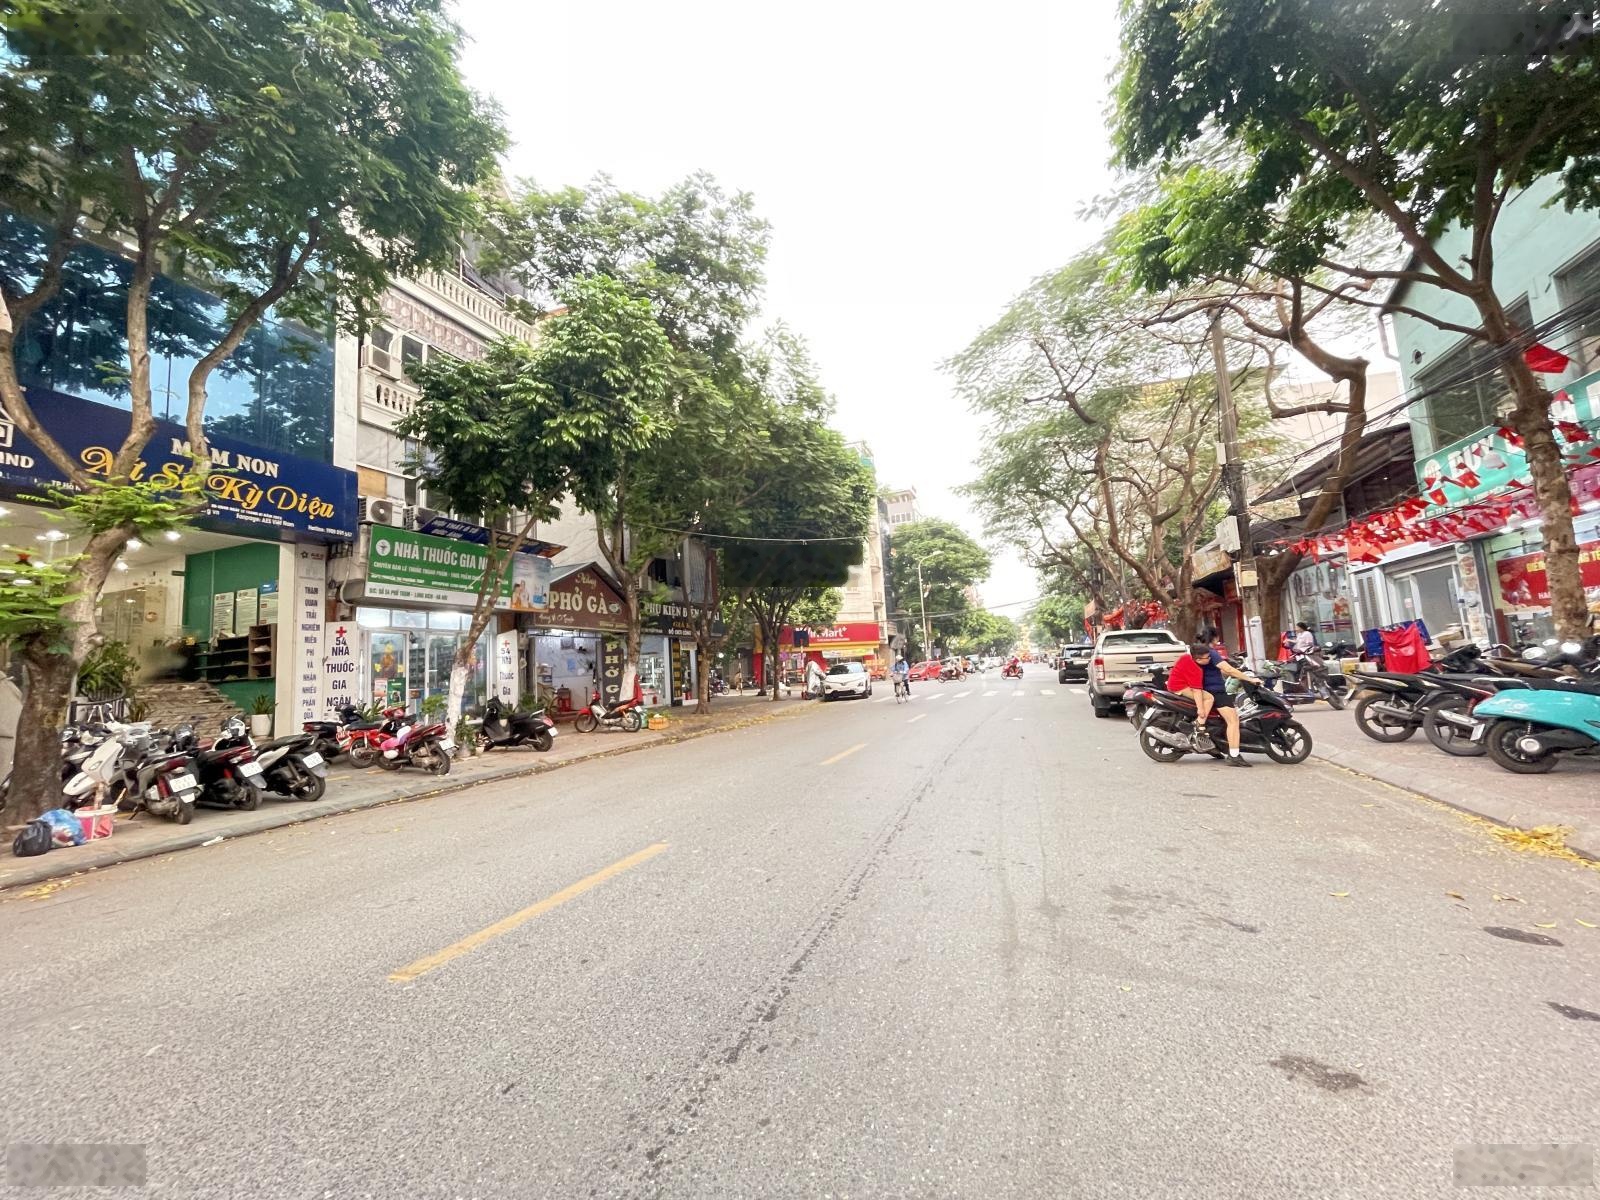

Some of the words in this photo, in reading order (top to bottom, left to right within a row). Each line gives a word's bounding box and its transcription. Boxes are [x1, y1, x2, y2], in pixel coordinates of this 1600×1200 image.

[170, 437, 230, 467] MM
[236, 453, 279, 479] NON
[207, 474, 264, 510] Kỳ
[267, 485, 335, 520] Diệu
[393, 540, 420, 560] NHÀ
[422, 545, 458, 567] THUỐC
[459, 553, 476, 569] GIA
[304, 586, 319, 595] THAM
[304, 599, 318, 607] QUAN
[549, 586, 583, 612] PHỞ
[586, 592, 608, 615] GÀ
[663, 602, 682, 618] KIỆN
[335, 636, 347, 646] 54
[326, 660, 355, 673] THUỐC
[332, 679, 347, 690] GIA
[502, 686, 511, 696] Gia
[326, 695, 351, 707] NGÂN
